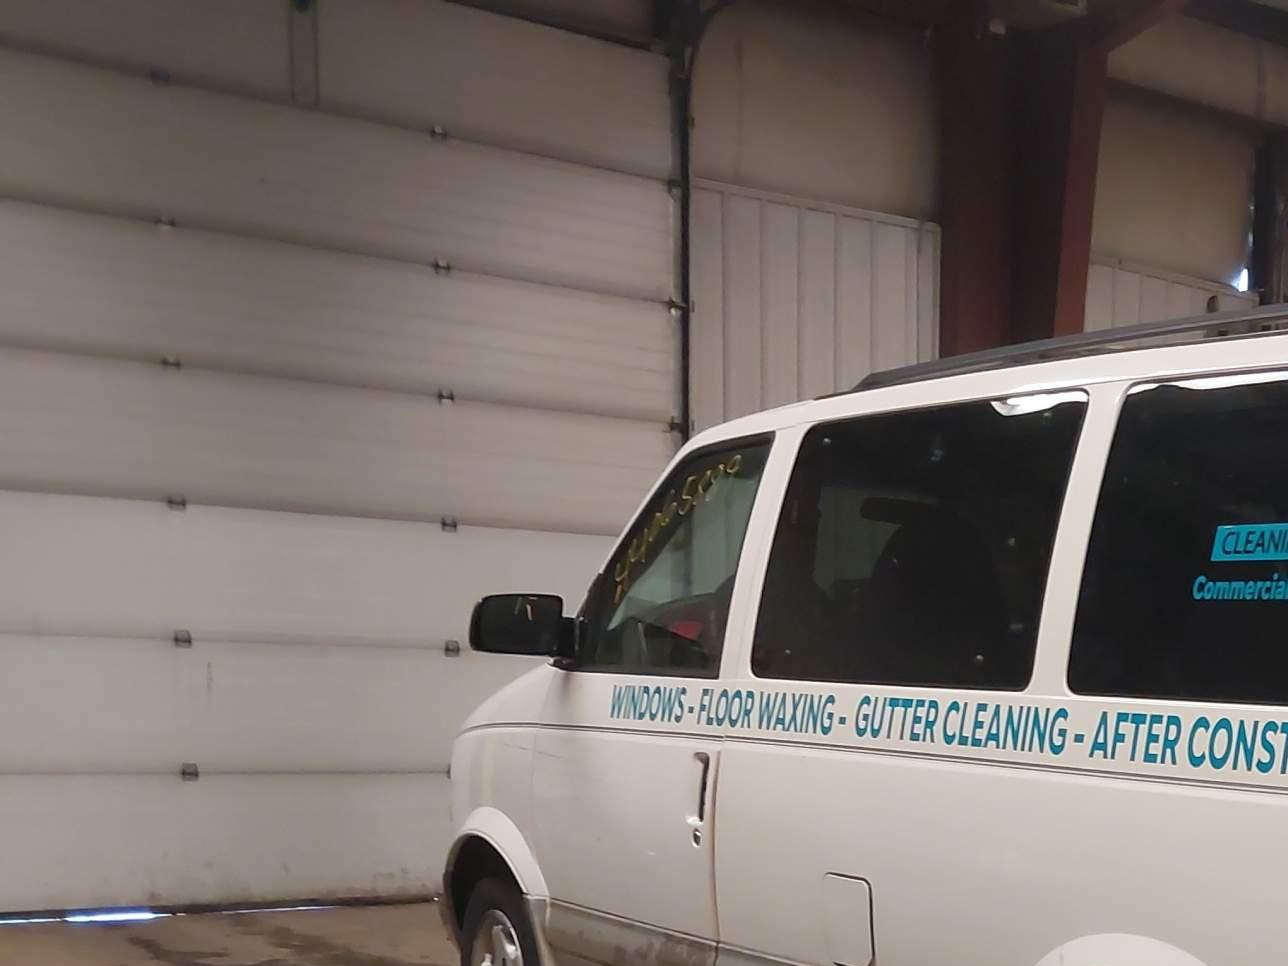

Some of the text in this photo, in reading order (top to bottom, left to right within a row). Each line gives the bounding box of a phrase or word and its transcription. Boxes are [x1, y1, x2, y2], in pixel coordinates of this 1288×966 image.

[609, 684, 687, 723] WINDOWS
[697, 687, 754, 730] FLOOR
[758, 691, 836, 736] WAXING
[855, 695, 938, 744] GUTTER
[942, 700, 1068, 756] CLEANING
[1089, 710, 1182, 765] AFTER
